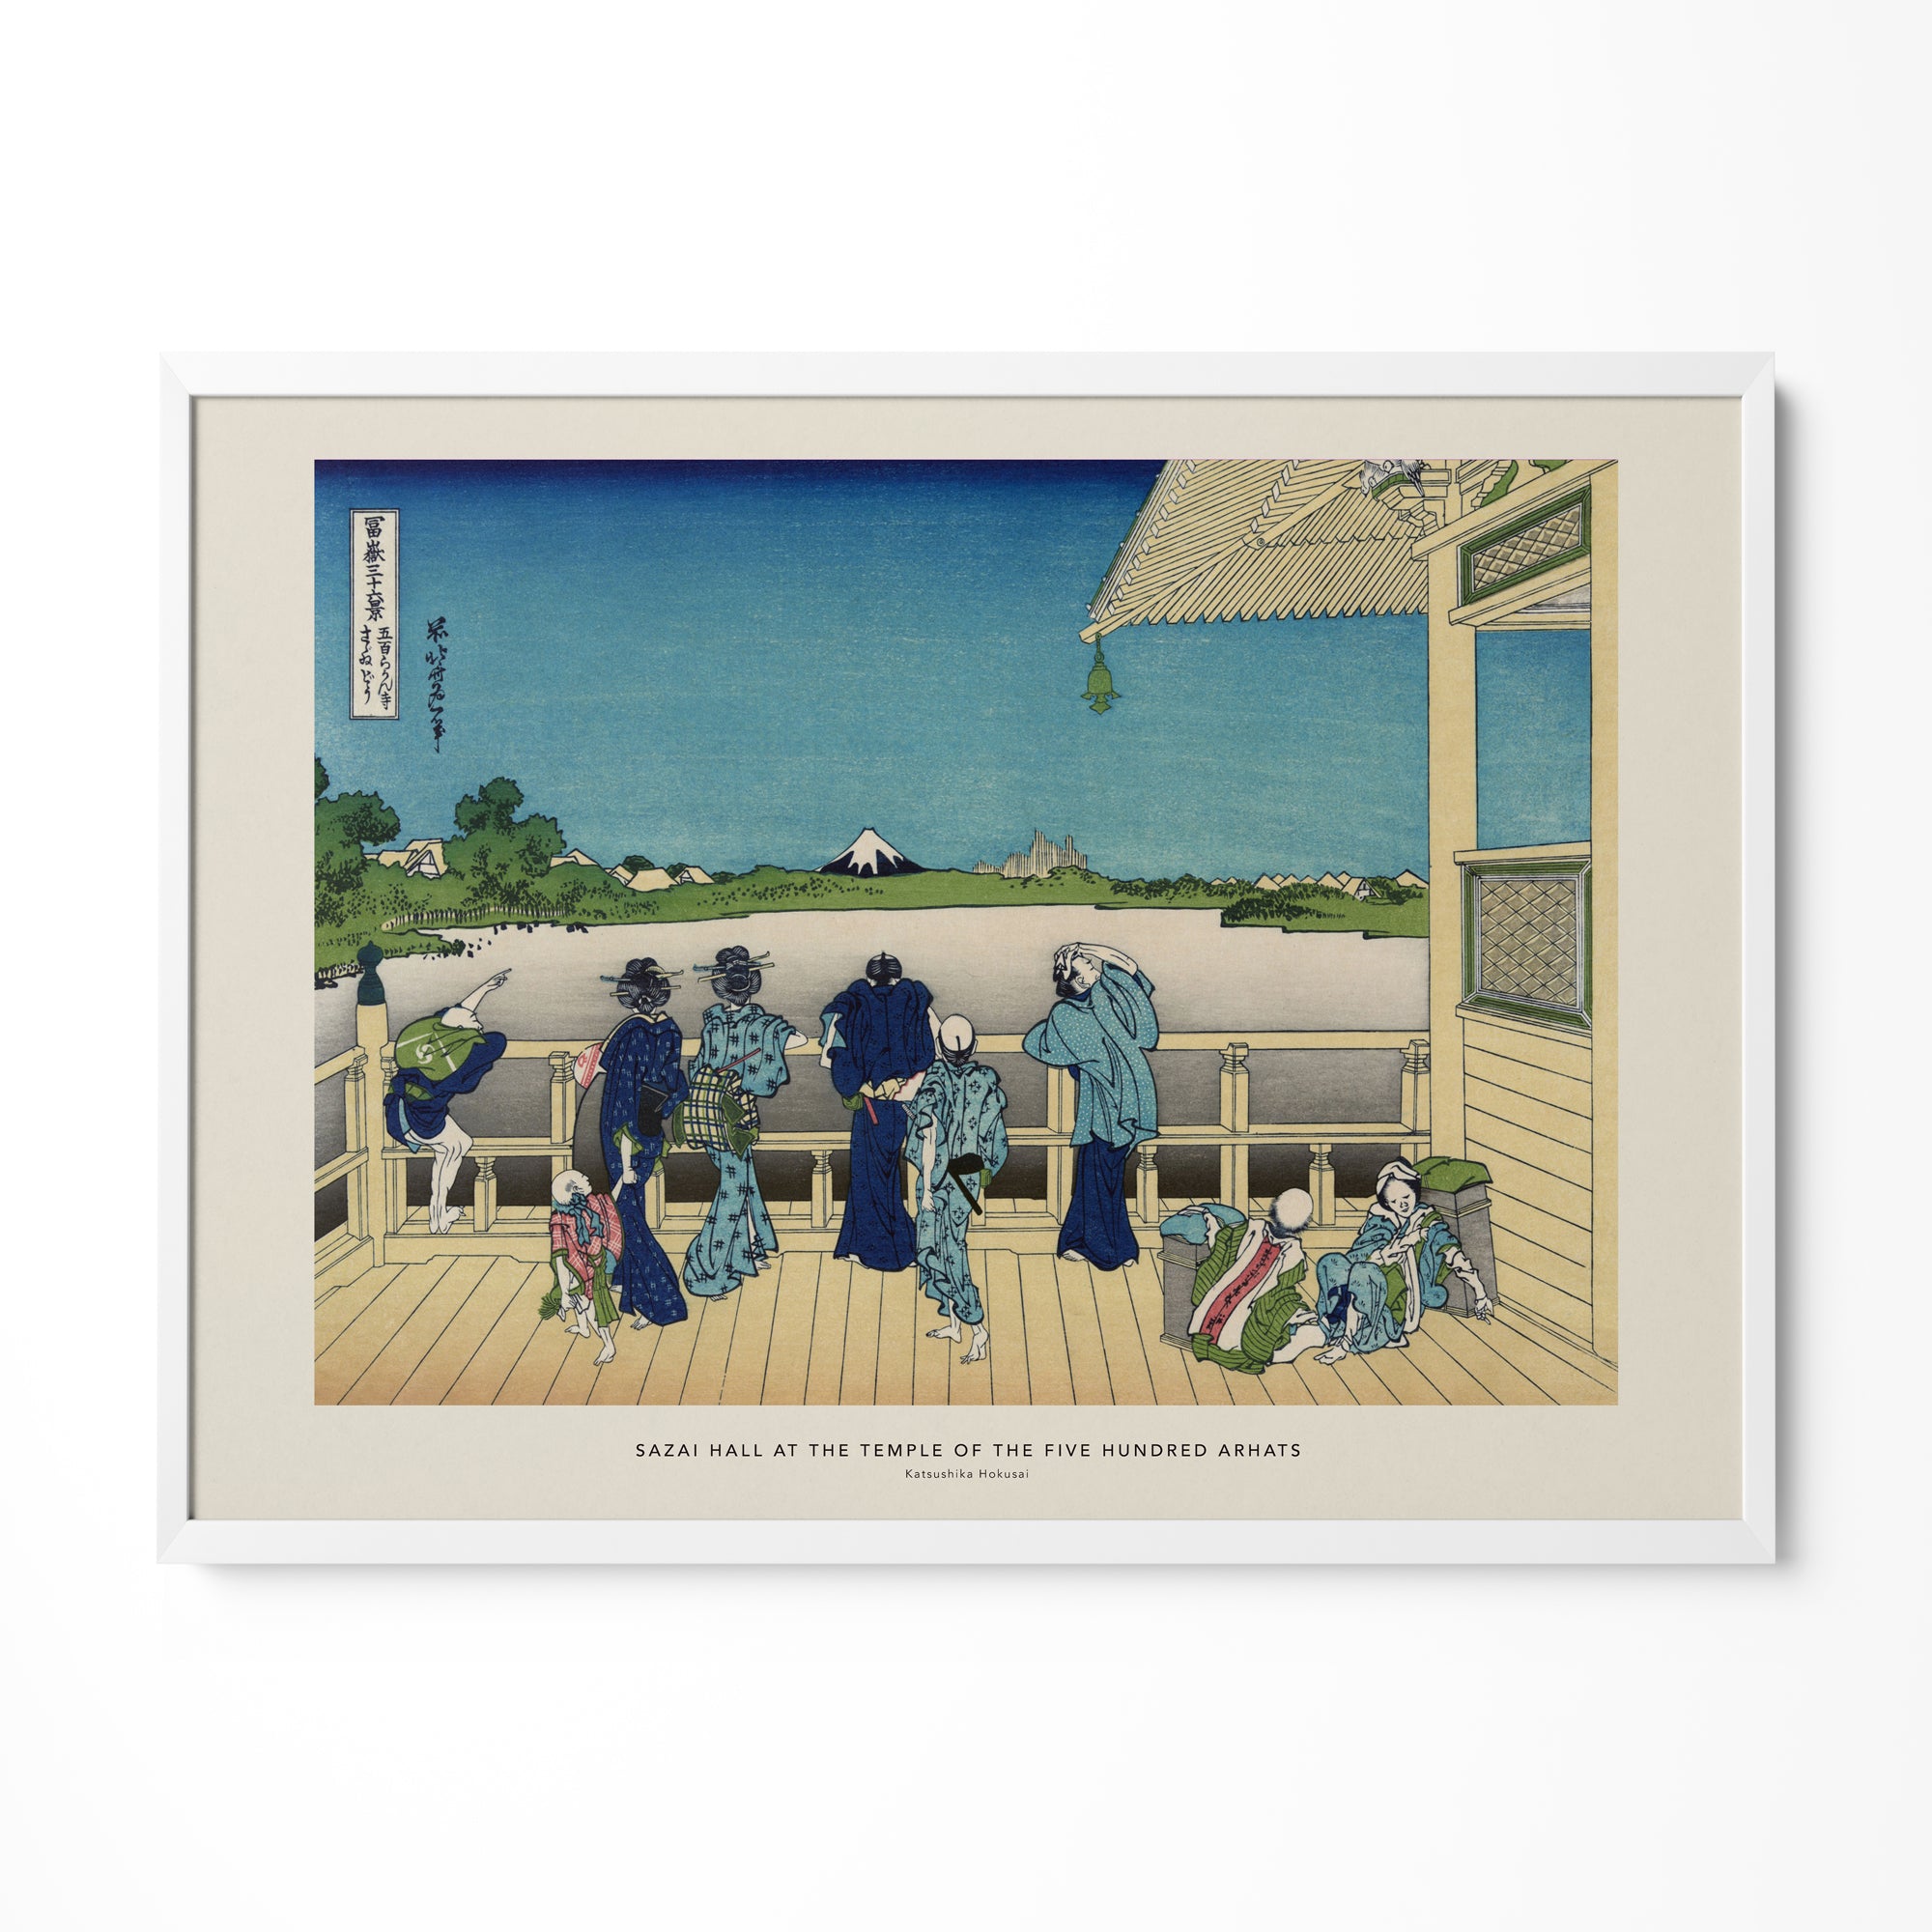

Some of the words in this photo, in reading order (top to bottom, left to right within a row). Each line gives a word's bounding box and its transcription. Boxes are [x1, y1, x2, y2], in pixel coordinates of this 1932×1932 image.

[636, 1443, 697, 1458] SAZAI
[710, 1443, 763, 1458] HALL
[773, 1443, 798, 1458] AT
[809, 1443, 849, 1458] THE
[860, 1443, 943, 1458] TEMPLE
[953, 1443, 981, 1458] OF
[993, 1443, 1033, 1458] THE
[1044, 1443, 1091, 1458] FIVE
[1102, 1443, 1208, 1458] HUNDRED
[1217, 1443, 1300, 1458] ARHATS
[905, 1468, 974, 1479] Katsushika
[979, 1468, 1029, 1479] Hokusai
